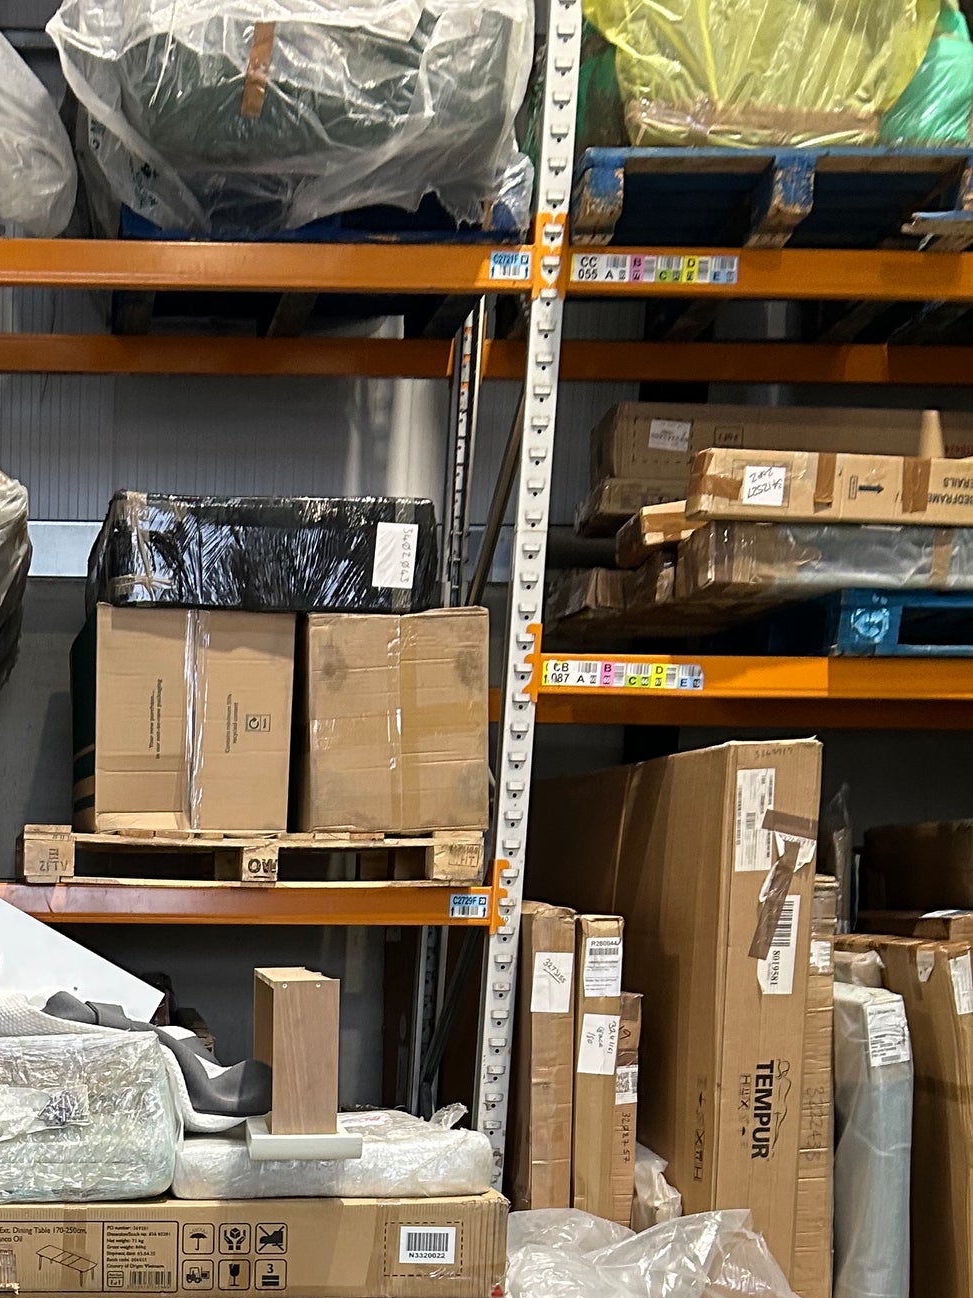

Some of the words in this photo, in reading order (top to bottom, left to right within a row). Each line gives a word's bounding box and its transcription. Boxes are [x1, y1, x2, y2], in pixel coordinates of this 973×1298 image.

[579, 256, 598, 268] CC
[632, 257, 641, 267] B
[578, 268, 598, 280] 055
[604, 269, 614, 280] A
[659, 270, 668, 280] C
[553, 662, 569, 672] CB
[604, 663, 612, 673] B
[655, 665, 664, 675] D
[551, 673, 570, 684] 087
[576, 675, 585, 684] A
[628, 676, 637, 686] C
[680, 678, 688, 688] E
[452, 895, 477, 905] C2729F
[770, 950, 781, 985] 8019581
[751, 1059, 775, 1159] TEMPUR
[12, 1226, 33, 1236] Dining
[33, 1226, 51, 1234] Table
[267, 1263, 274, 1273] 3
